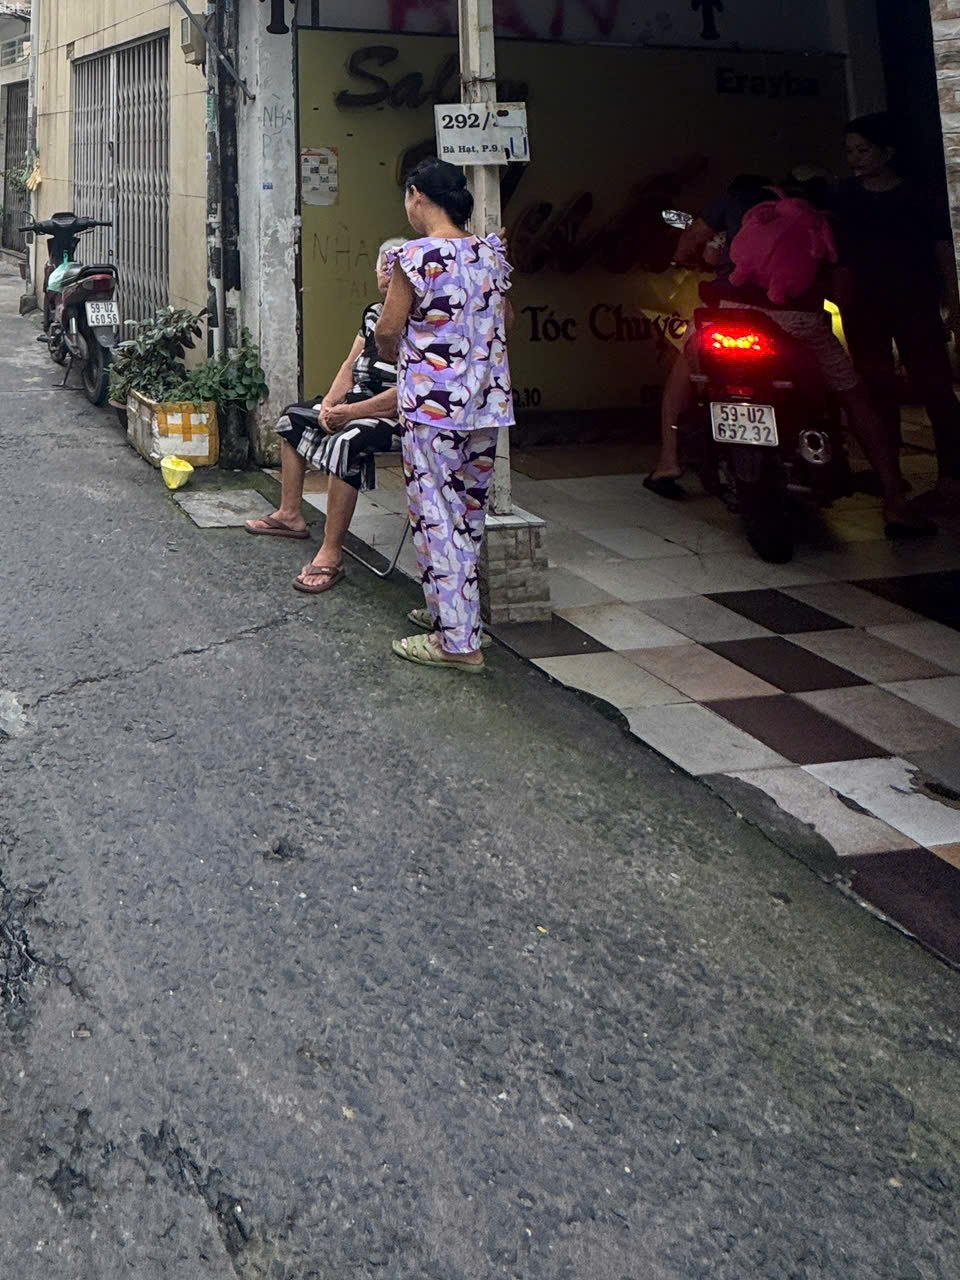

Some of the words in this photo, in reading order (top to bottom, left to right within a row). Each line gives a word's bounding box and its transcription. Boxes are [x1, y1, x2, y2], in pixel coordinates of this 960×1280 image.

[442, 145, 456, 154] Bà
[521, 305, 576, 341] Tóc
[720, 406, 766, 424] 59-U2
[717, 422, 772, 442] 652.32
